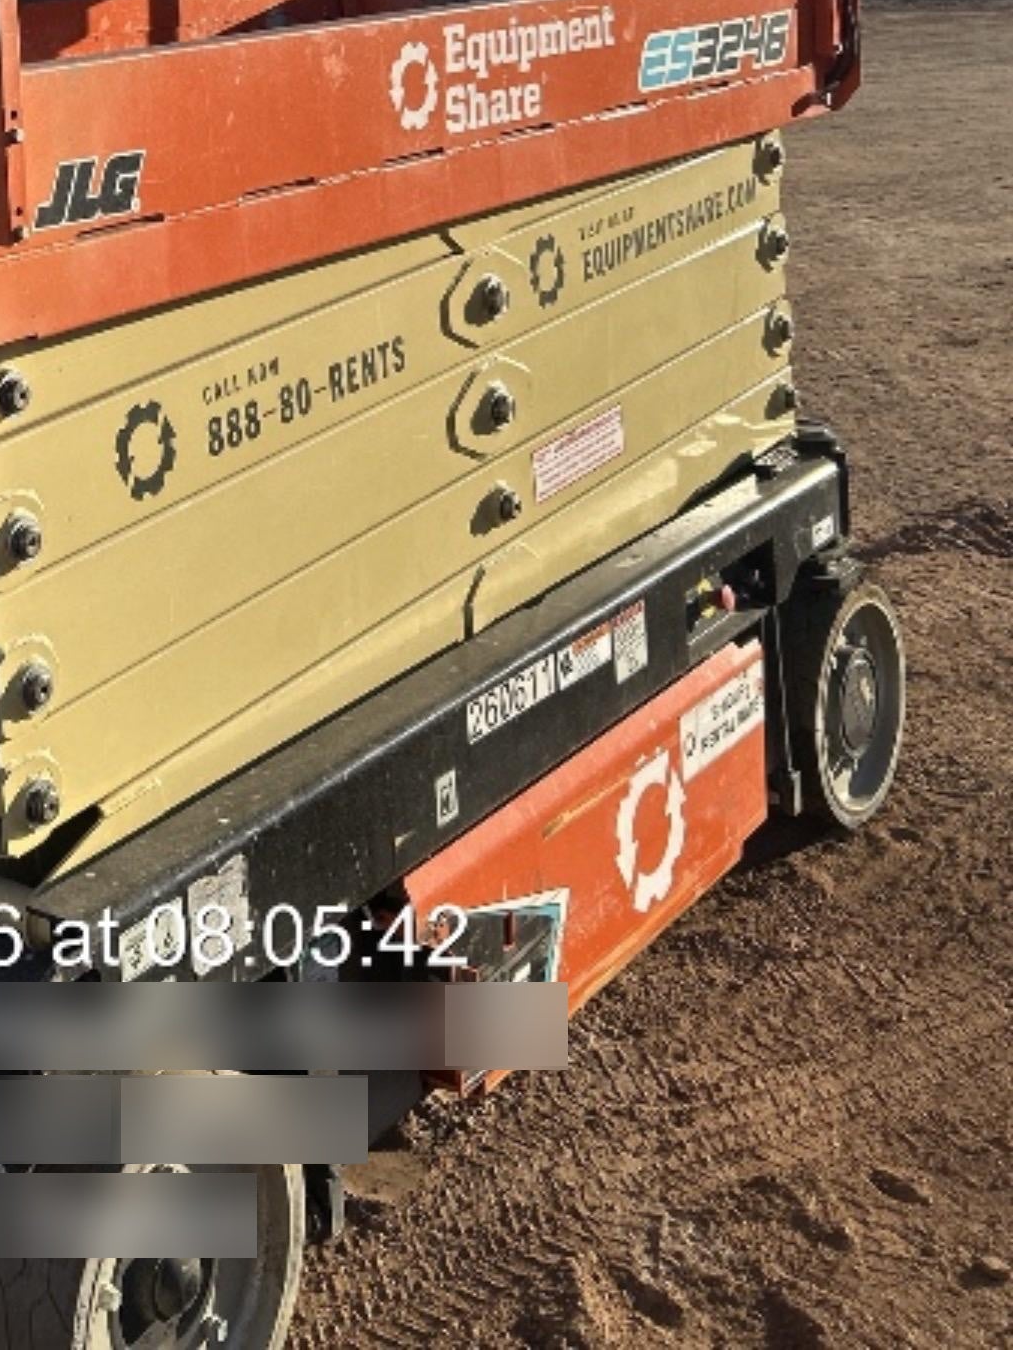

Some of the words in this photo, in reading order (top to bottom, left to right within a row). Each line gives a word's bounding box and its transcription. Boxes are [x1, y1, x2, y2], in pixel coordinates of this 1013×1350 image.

[442, 5, 615, 79] Equipment
[638, 9, 792, 94] ES3246
[445, 81, 542, 134] Share
[31, 149, 146, 232] JLG
[202, 373, 242, 406] CALL
[207, 335, 408, 457] 888-80-RENTS
